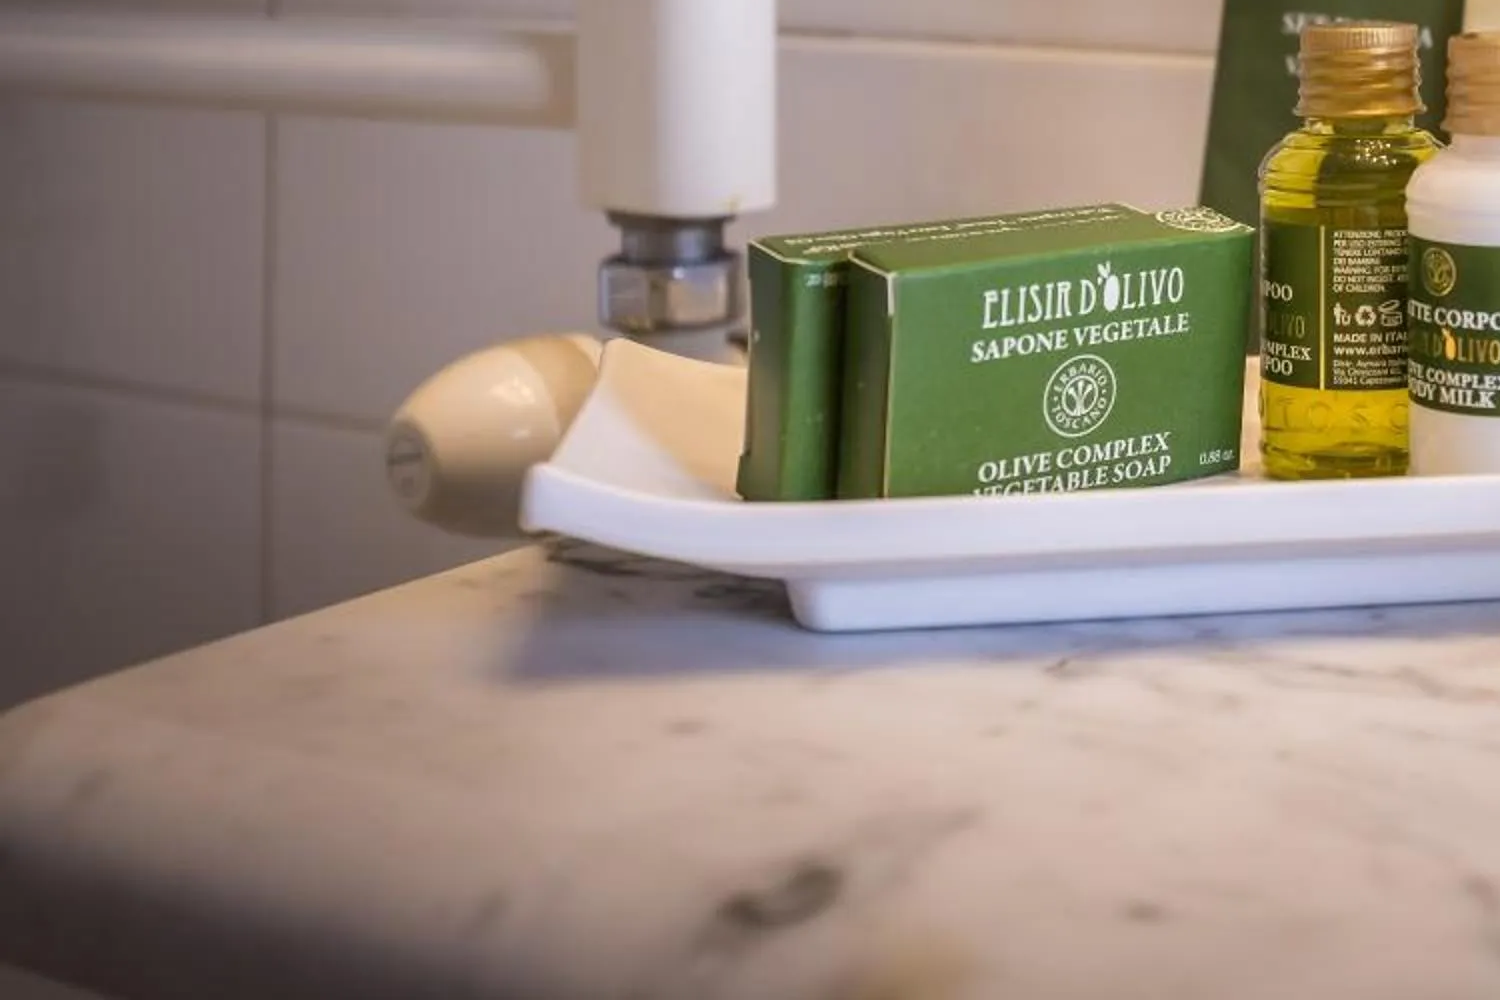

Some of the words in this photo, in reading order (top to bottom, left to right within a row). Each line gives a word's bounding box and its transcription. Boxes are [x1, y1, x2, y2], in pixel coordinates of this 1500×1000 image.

[981, 280, 1073, 329] ELISIR
[970, 329, 1069, 364] SAPONE
[1073, 311, 1190, 347] VEGETALE
[1439, 385, 1496, 409] MILK
[977, 451, 1051, 484] OLIVE
[1055, 431, 1173, 469] COMPLEX
[1112, 454, 1172, 484] SOAP
